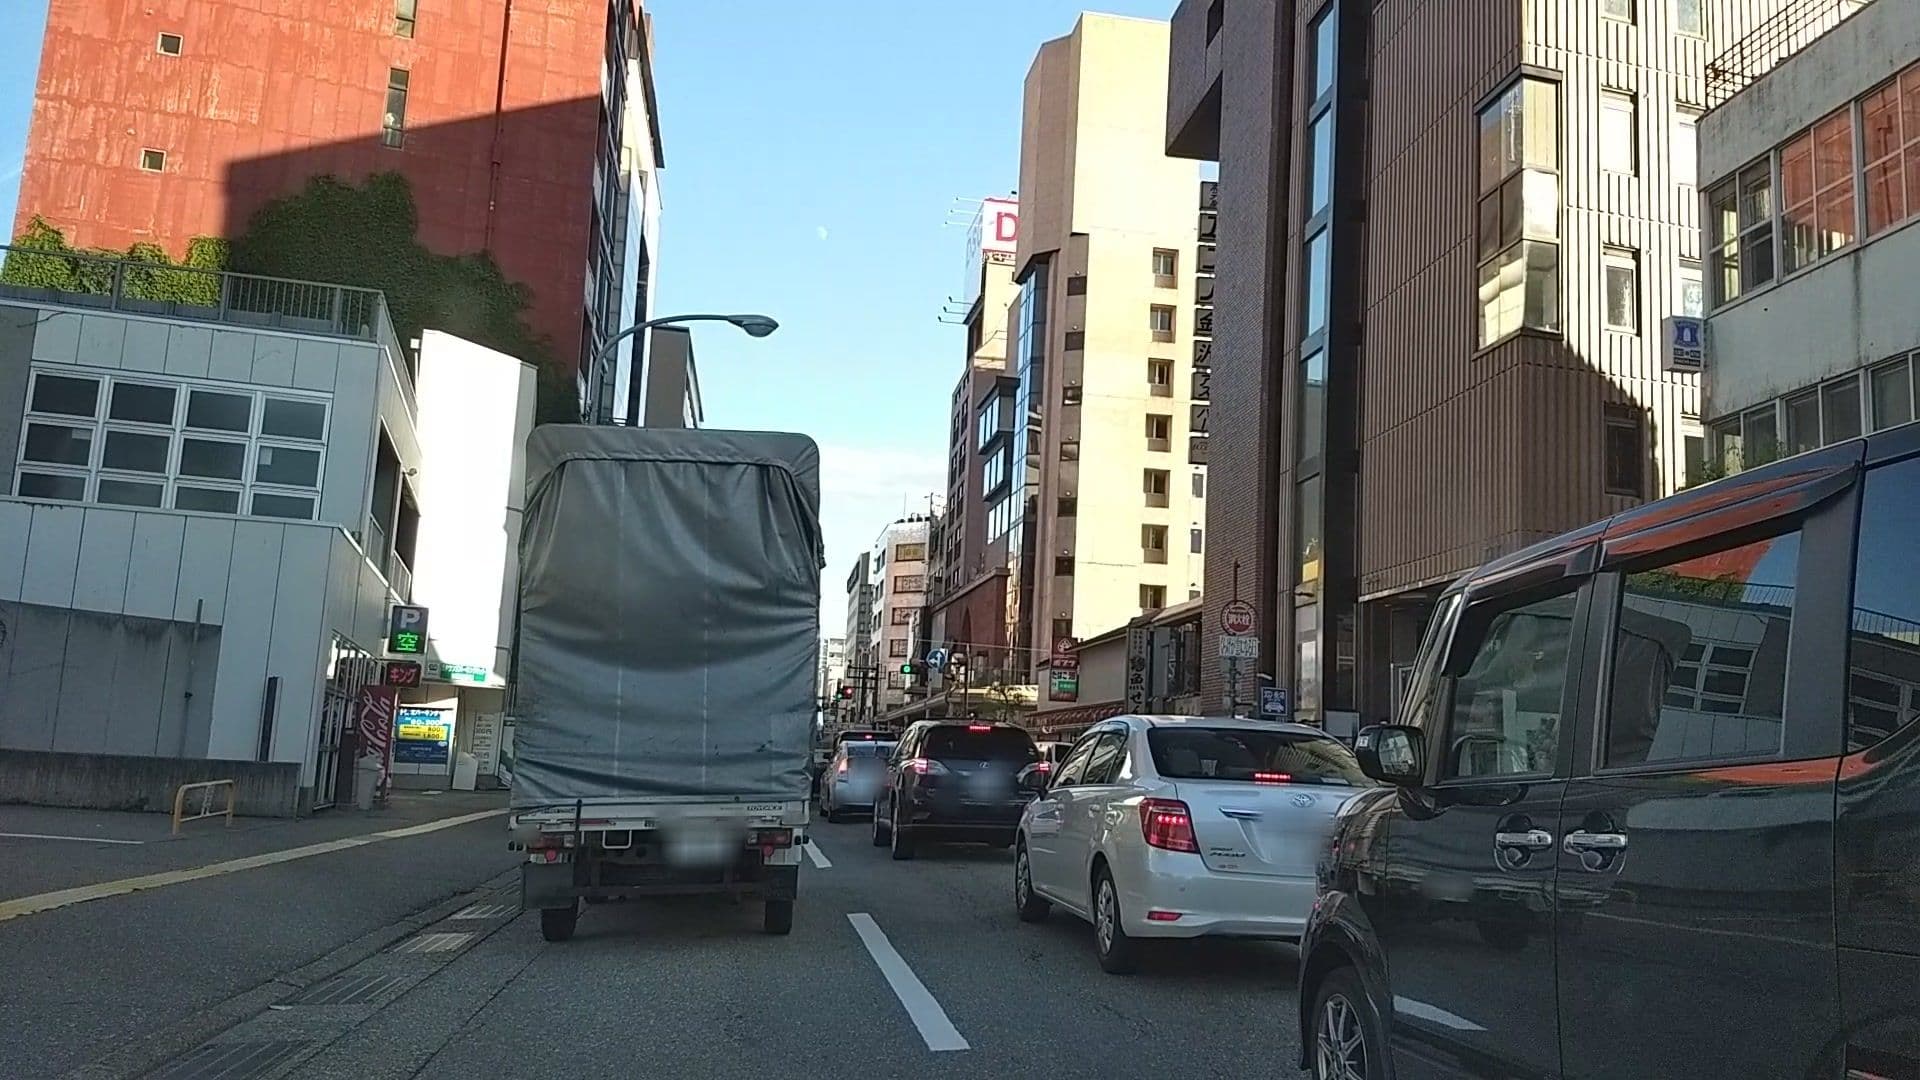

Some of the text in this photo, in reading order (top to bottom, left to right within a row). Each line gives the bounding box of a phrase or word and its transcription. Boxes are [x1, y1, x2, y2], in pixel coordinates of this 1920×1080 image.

[400, 609, 420, 628] P
[1228, 613, 1249, 625] 消火栓
[396, 632, 419, 652] 空
[389, 667, 417, 684] キング
